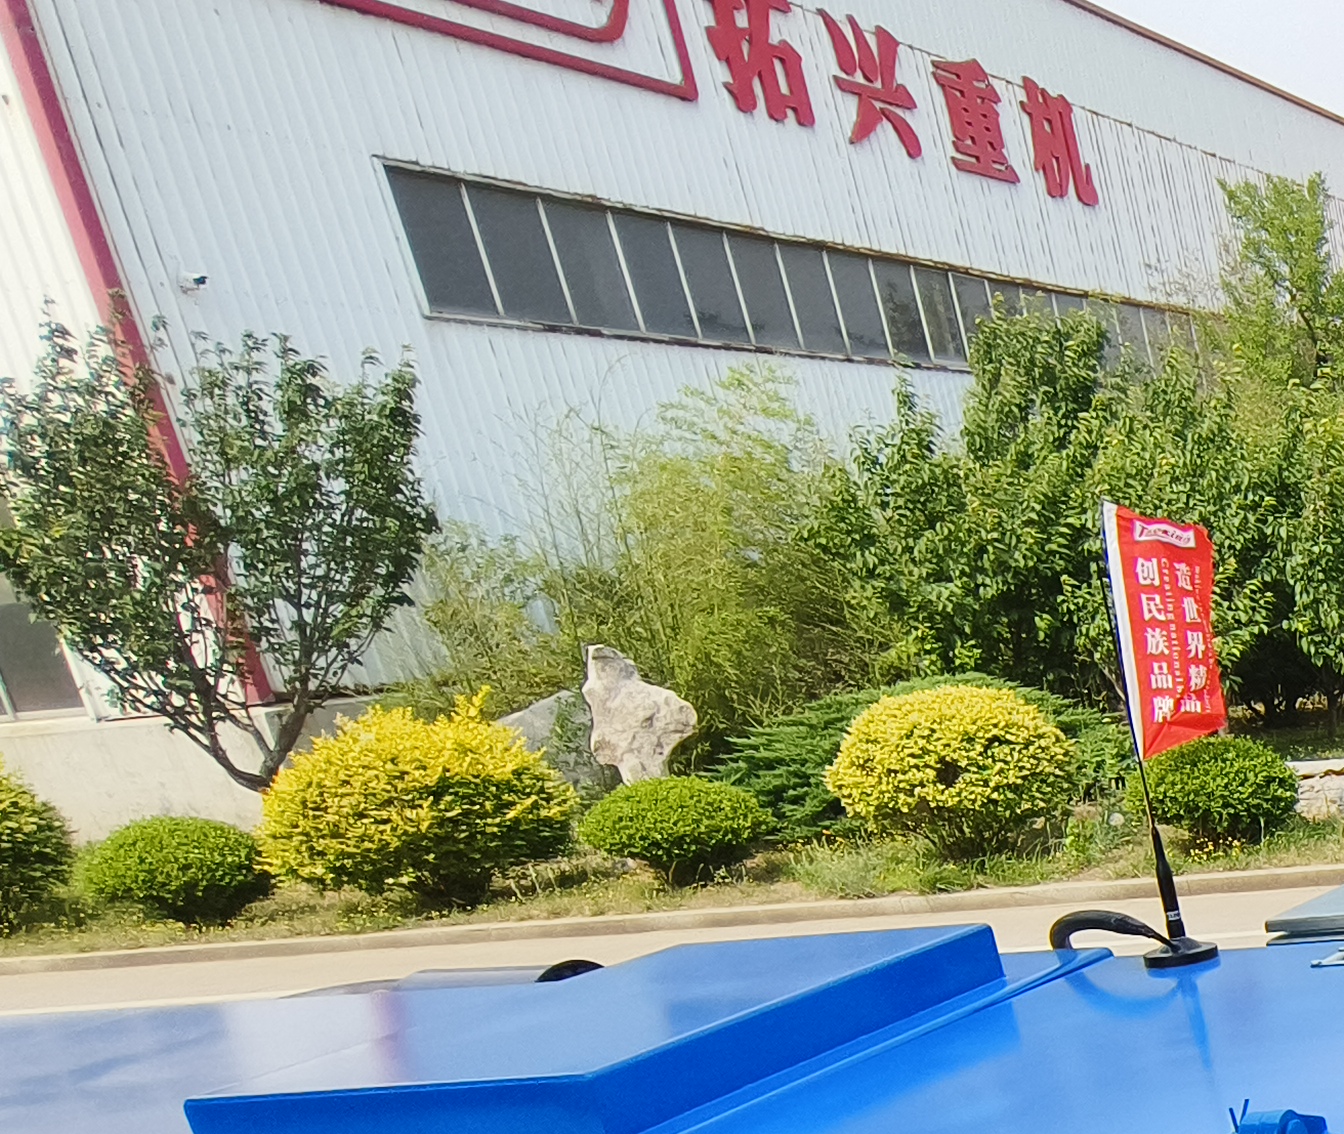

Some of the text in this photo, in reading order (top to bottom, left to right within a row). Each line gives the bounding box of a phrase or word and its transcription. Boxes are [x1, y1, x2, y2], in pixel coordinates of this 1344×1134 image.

[705, 0, 1099, 206] 拓兴重机
[1135, 557, 1175, 723] 创民族品牌
[1174, 563, 1207, 713] 造世界精品
